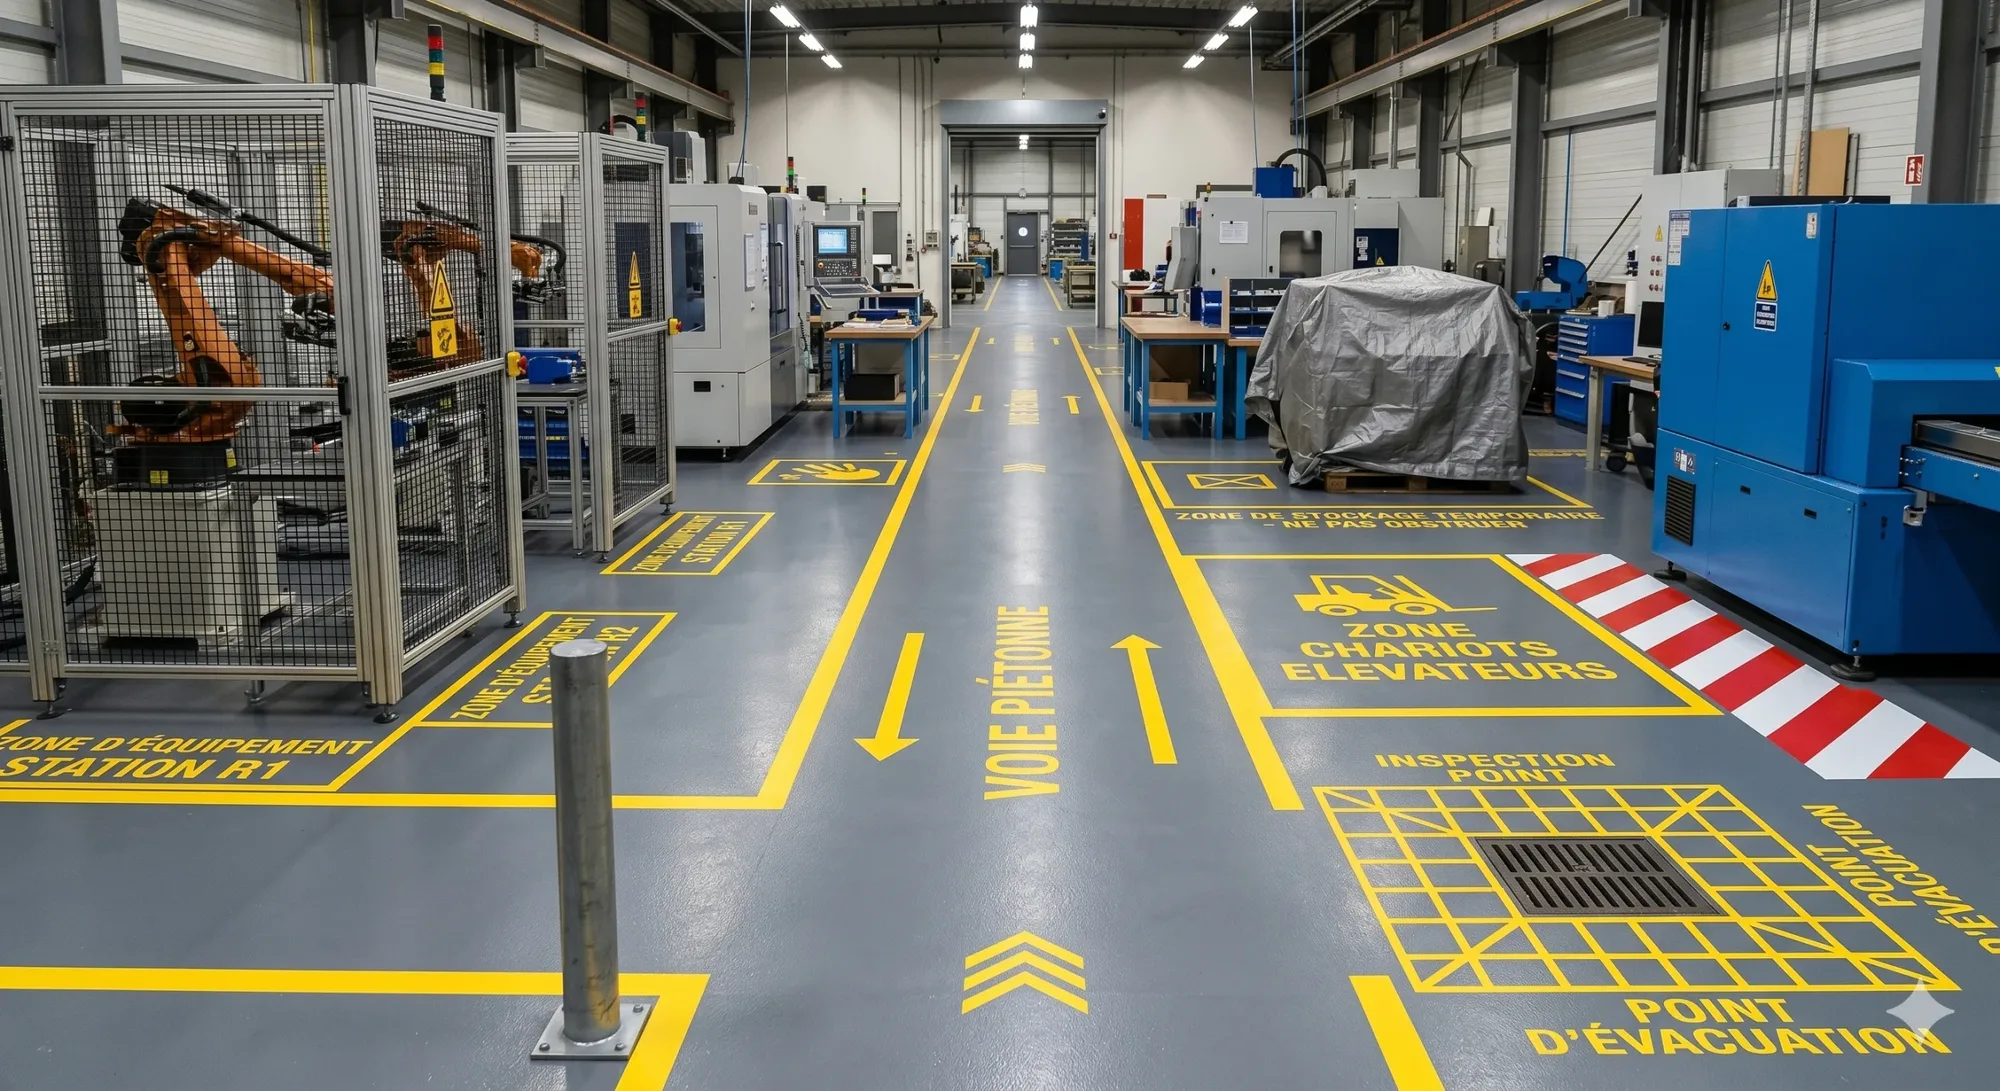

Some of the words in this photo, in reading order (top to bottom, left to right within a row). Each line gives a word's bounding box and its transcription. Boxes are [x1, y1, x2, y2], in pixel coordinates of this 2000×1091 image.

[1175, 512, 1244, 520] ZONE
[1250, 512, 1285, 520] DE
[1291, 512, 1429, 520] STOCKAGE
[1432, 512, 1605, 520] TEMPORAIRE
[1283, 520, 1320, 529] NE
[1326, 520, 1377, 529] PAS
[1384, 520, 1528, 529] OBSTRUER
[681, 531, 740, 563] STATION
[715, 521, 749, 530] R1
[1342, 623, 1476, 638] ZONE
[975, 605, 1056, 716] PIÉTONNE
[1300, 641, 1558, 658] CHARIOTS
[1280, 661, 1618, 681] ELEVATEURS
[449, 687, 516, 719] ZONE
[0, 736, 95, 751] ZONE
[93, 735, 374, 755] D'ÉQUIPEMENT
[0, 756, 216, 779] STATION
[216, 760, 290, 780] R1
[984, 724, 1060, 801] VOIE
[1374, 753, 1616, 768] INSPECTION
[1447, 769, 1569, 784] POINT
[1805, 844, 1918, 907] POINT
[1623, 998, 1795, 1024] POINT
[1524, 1022, 1953, 1055] D'ÉVACUATION
